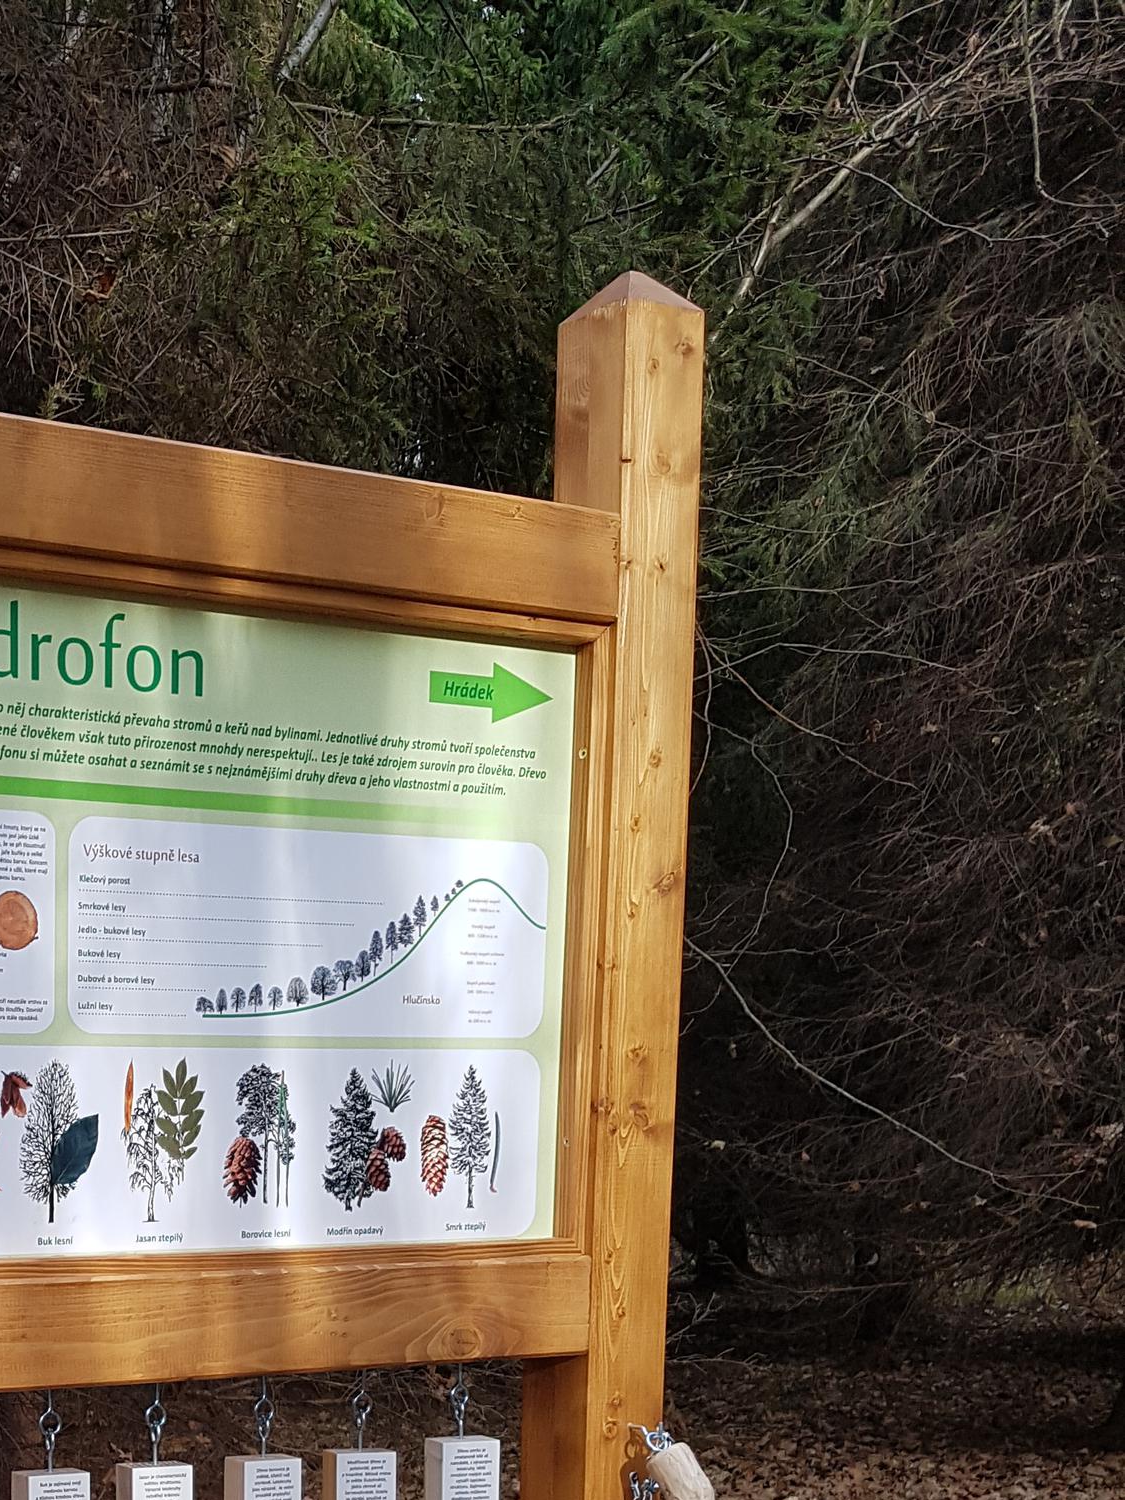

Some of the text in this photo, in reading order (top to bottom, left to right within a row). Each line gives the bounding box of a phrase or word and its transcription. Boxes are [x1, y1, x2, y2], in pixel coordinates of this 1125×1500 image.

[443, 680, 494, 702] Hrádek
[6, 701, 26, 718] něj
[28, 703, 121, 723] charakteristická
[122, 712, 170, 728] převaha
[172, 718, 212, 732] stromů
[214, 723, 222, 732] a
[224, 721, 248, 735] keřů
[250, 725, 272, 737] nad
[273, 725, 322, 741] bylinami.
[324, 730, 378, 746] Jednotlivé
[379, 735, 410, 751] druhy
[411, 738, 447, 751] stromů
[449, 742, 473, 754] tvoří
[473, 744, 535, 759] společenstva
[20, 724, 75, 742] člověkem
[78, 729, 104, 744] však
[107, 733, 131, 746] tuto
[133, 734, 197, 752] přirozenost
[198, 741, 244, 758] mnohdy
[320, 750, 338, 763] Les
[337, 751, 349, 766] je
[351, 753, 374, 766] také
[376, 755, 417, 771] zdrojem
[418, 760, 455, 772] surovin
[457, 764, 474, 775] pro
[476, 762, 515, 776] člověka.
[518, 766, 546, 779] Dřevo
[29, 747, 40, 760] si
[42, 748, 85, 764] můžete
[87, 753, 127, 767] osahat
[129, 759, 137, 768] a
[139, 758, 190, 772] seznámit
[192, 763, 204, 773] se
[206, 764, 213, 774] s
[294, 768, 325, 785] druhy
[327, 771, 357, 784] dřeva
[359, 776, 366, 785] a
[366, 774, 390, 788] jeho
[393, 776, 451, 791] vlastnostmi
[452, 783, 459, 792] a
[82, 843, 199, 865] Výškové stupně lesa
[107, 877, 130, 886] porost
[77, 901, 126, 913] Smrkové lesy
[77, 925, 97, 933] Jedlo
[103, 925, 130, 935] bukové
[131, 927, 146, 937] lesy
[77, 948, 120, 959] Bukové lesy
[77, 974, 105, 982] Dubové
[113, 975, 138, 983] borové
[140, 975, 155, 985] lesy
[402, 994, 440, 1004] Hlučínsko
[77, 1001, 112, 1011] Lužní lesy
[326, 1225, 383, 1236] Modřín opadavý
[445, 1221, 486, 1232] Smrk ztepilý
[135, 1232, 183, 1243] Jasan ztepilý
[240, 1229, 290, 1239] Borovice lesní
[37, 1235, 72, 1245] Buk lesní
